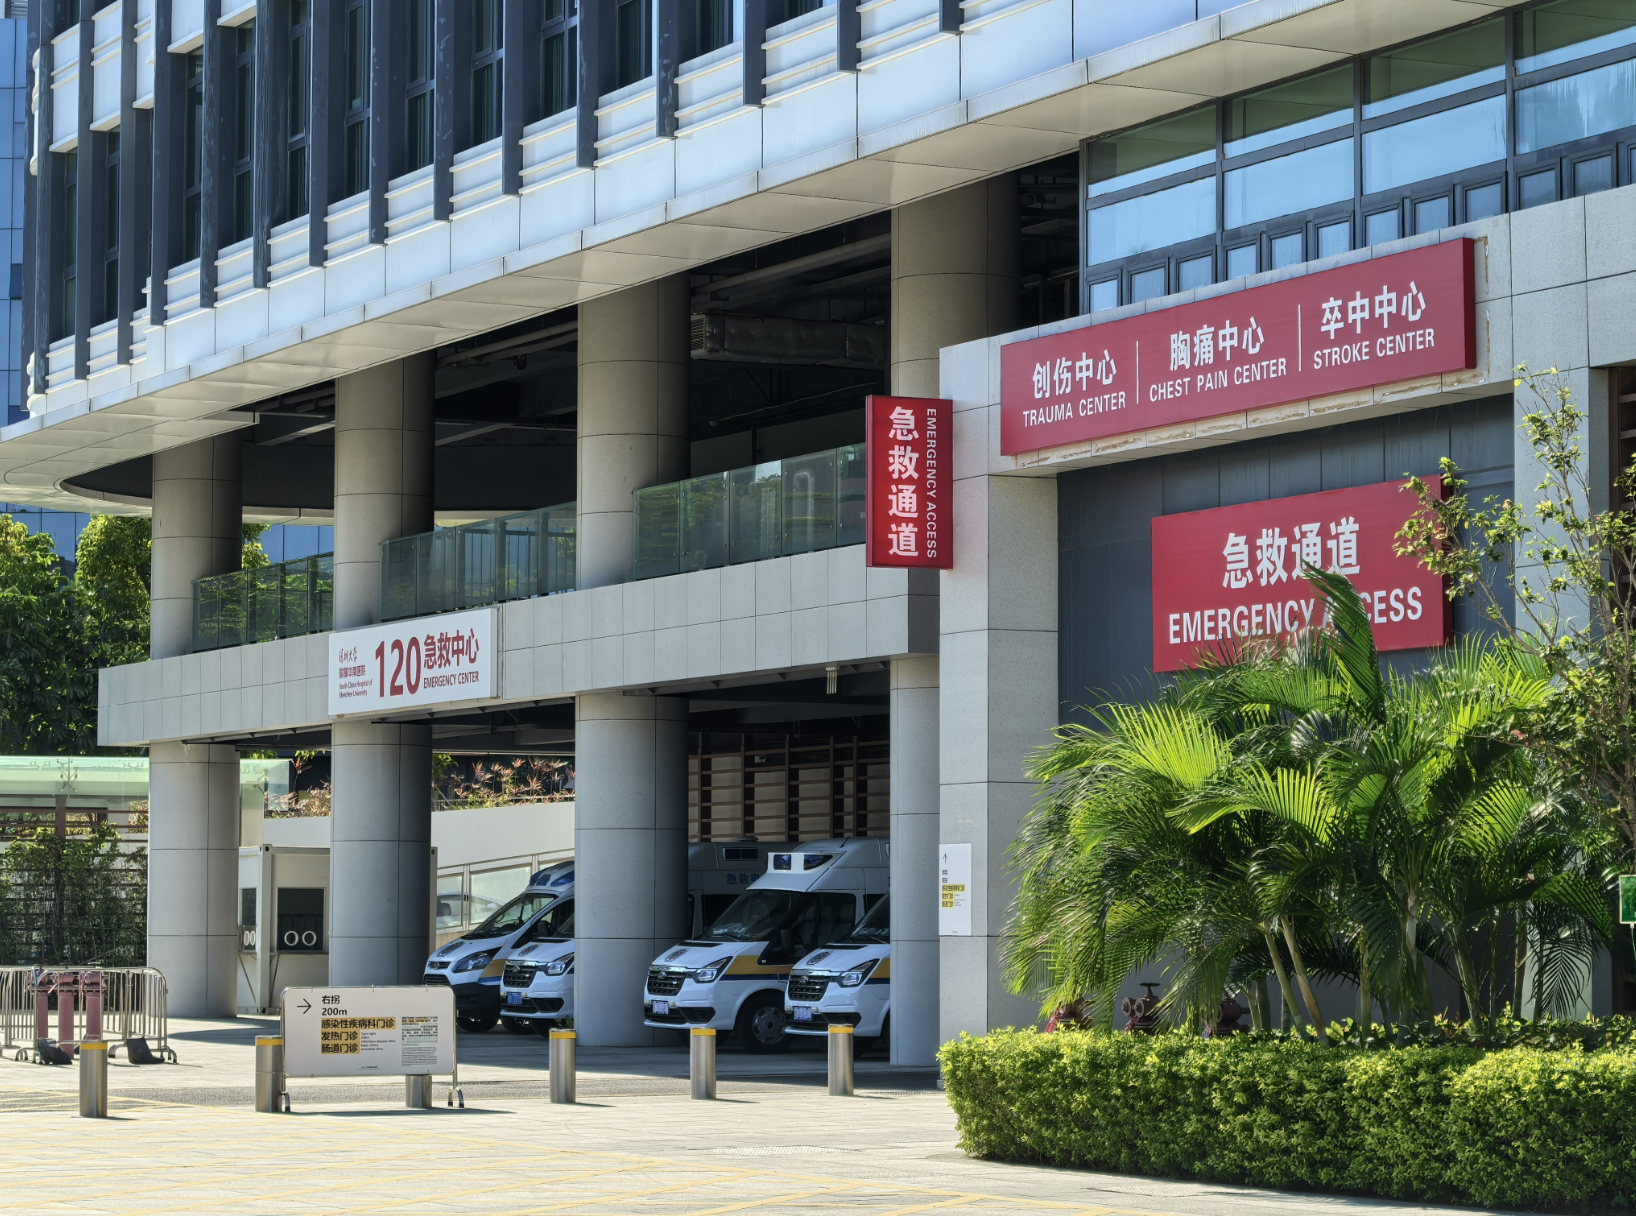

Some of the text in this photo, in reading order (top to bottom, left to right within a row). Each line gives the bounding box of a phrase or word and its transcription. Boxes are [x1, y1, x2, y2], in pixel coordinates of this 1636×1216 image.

[1320, 280, 1427, 340] 卒中中心
[1169, 316, 1265, 371] 胸痛中心
[1313, 328, 1435, 370] STROKE CENTER
[1032, 349, 1117, 400] 创伤中心
[1149, 357, 1287, 403] CHEST PAIN CENTER
[1022, 391, 1126, 428] TRAUMA CENTER
[888, 406, 919, 557] 急救通道
[926, 408, 937, 558] EMERGENCY ACCESS
[1222, 516, 1361, 589] 急救通道
[1169, 598, 1315, 645] EMERGENCY
[375, 628, 480, 698] 120 急救中心
[423, 670, 480, 689] EMERGENCY CENTER
[321, 994, 340, 1005] 右拐
[321, 1007, 348, 1016] 200m
[321, 1018, 395, 1029] 感染性疾病科门诊
[321, 1031, 359, 1041] 发热门诊
[321, 1043, 359, 1054] 肠道门诊
